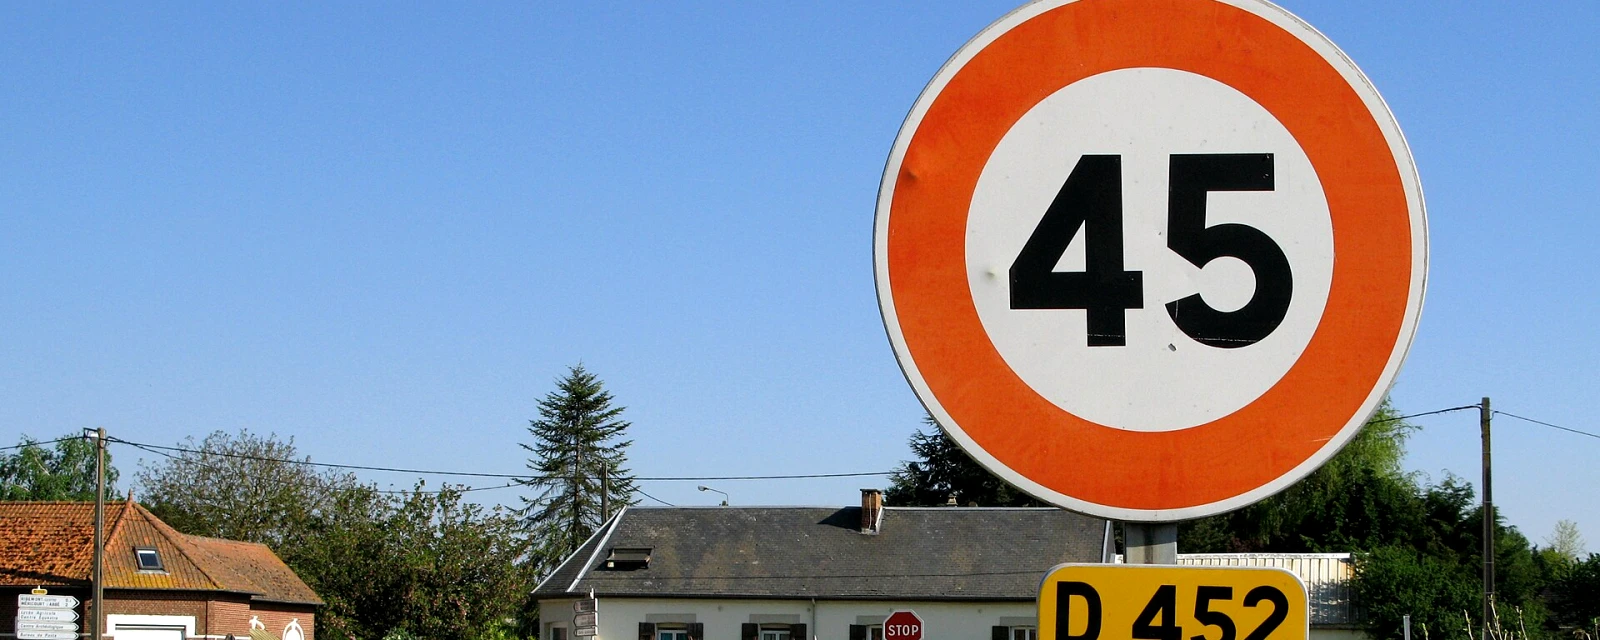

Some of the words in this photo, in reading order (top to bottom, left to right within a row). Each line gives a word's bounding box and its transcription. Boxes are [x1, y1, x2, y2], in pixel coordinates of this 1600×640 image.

[1009, 153, 1293, 348] 45
[888, 624, 919, 636] STOP
[1055, 581, 1102, 640] D
[1132, 584, 1289, 640] 452
